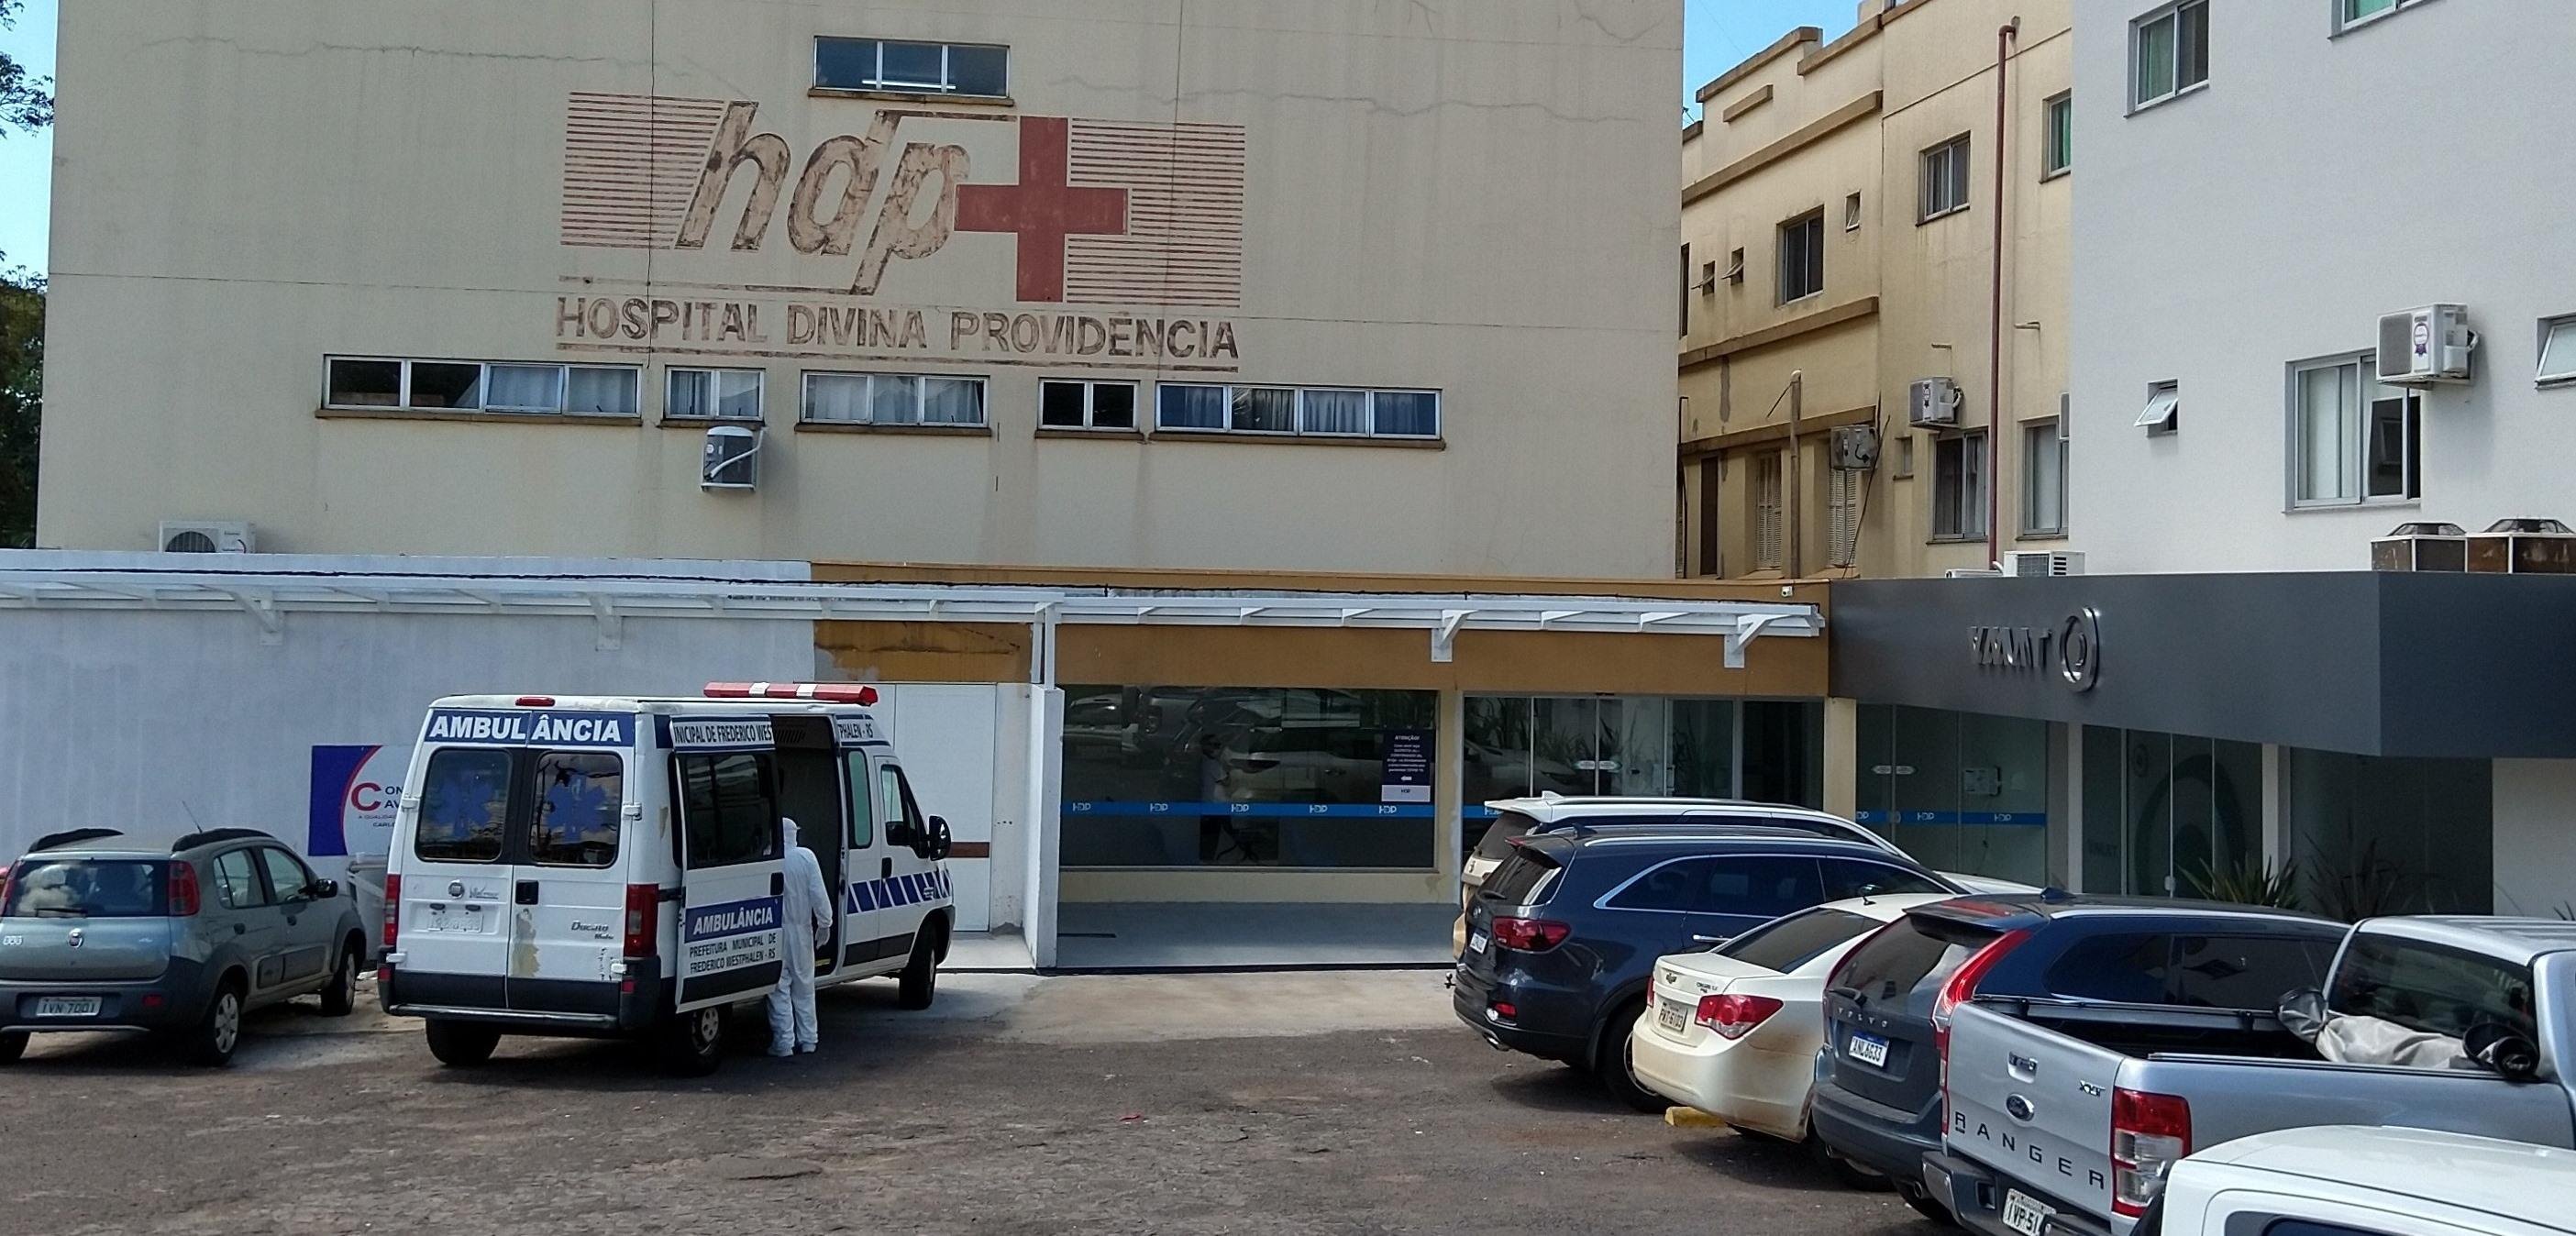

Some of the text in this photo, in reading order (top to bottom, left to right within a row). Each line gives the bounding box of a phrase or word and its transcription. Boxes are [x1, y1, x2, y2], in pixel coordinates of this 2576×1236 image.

[556, 295, 1239, 359] HOSPITAL DIVINA PROVIDÊNCIA
[705, 725, 716, 743] DE
[717, 724, 756, 742] FREDERICO
[693, 907, 773, 934] AMBULÂNCIA
[690, 933, 776, 958] PREFEITURA MUNICIPAL DE
[691, 957, 724, 974] FREDERICO
[726, 951, 764, 967] WESTPHALEN
[768, 948, 776, 959] RS
[1839, 1007, 1888, 1028] VOLVO
[1955, 1111, 2105, 1190] RANGER
